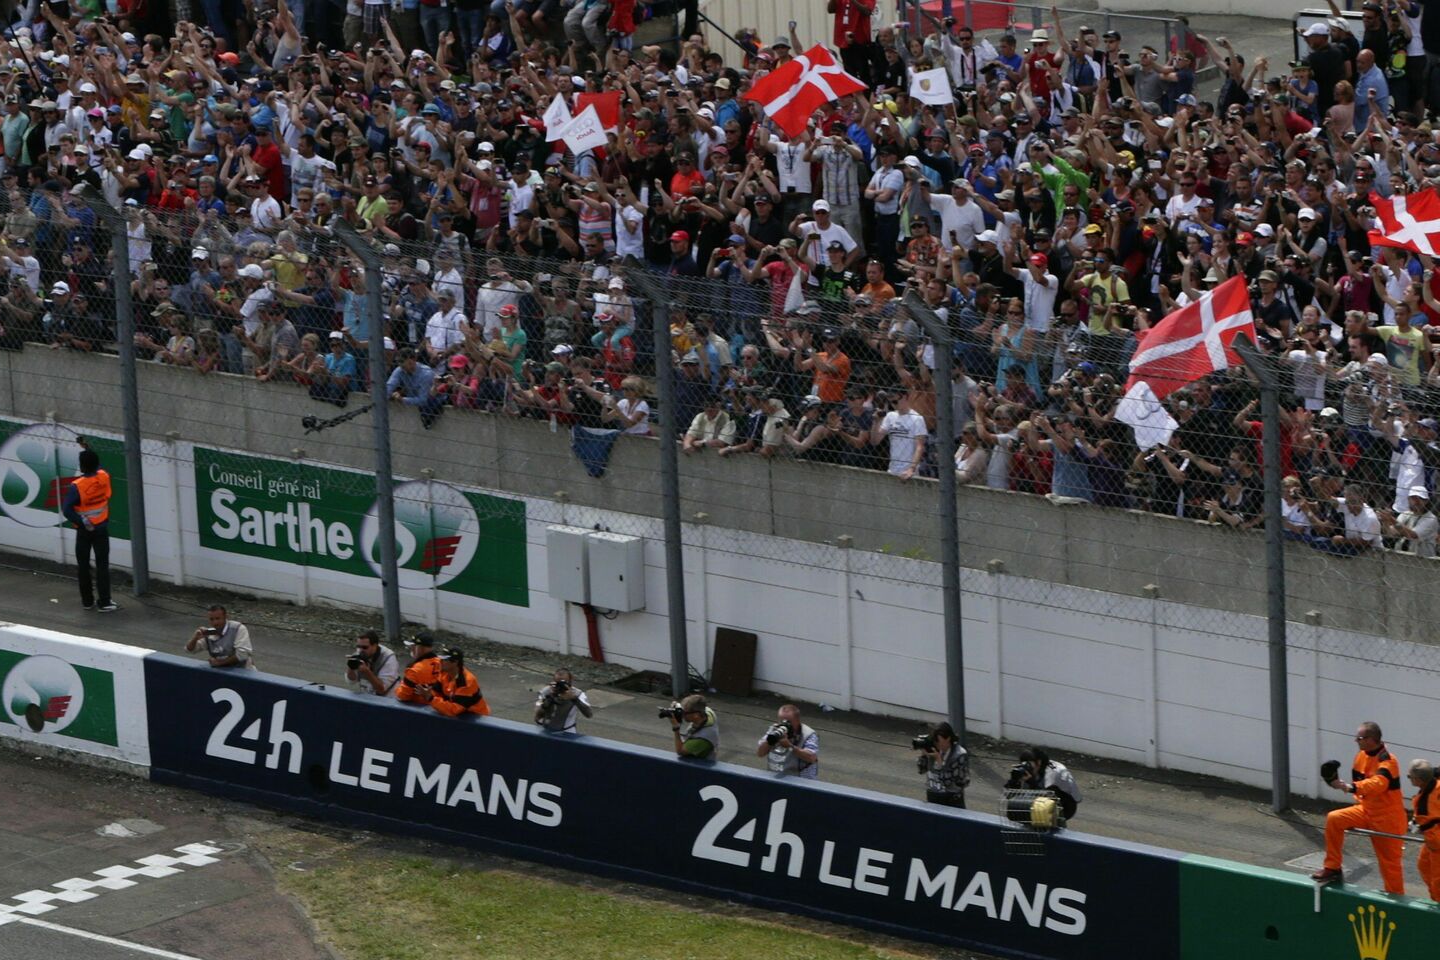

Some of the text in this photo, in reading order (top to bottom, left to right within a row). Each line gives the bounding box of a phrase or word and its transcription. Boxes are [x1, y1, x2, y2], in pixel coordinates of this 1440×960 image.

[209, 462, 321, 501] Conseil général
[209, 488, 356, 561] Sarthe
[205, 687, 563, 828] 24h LE MANS
[691, 784, 1088, 936] 24h LE MANS
